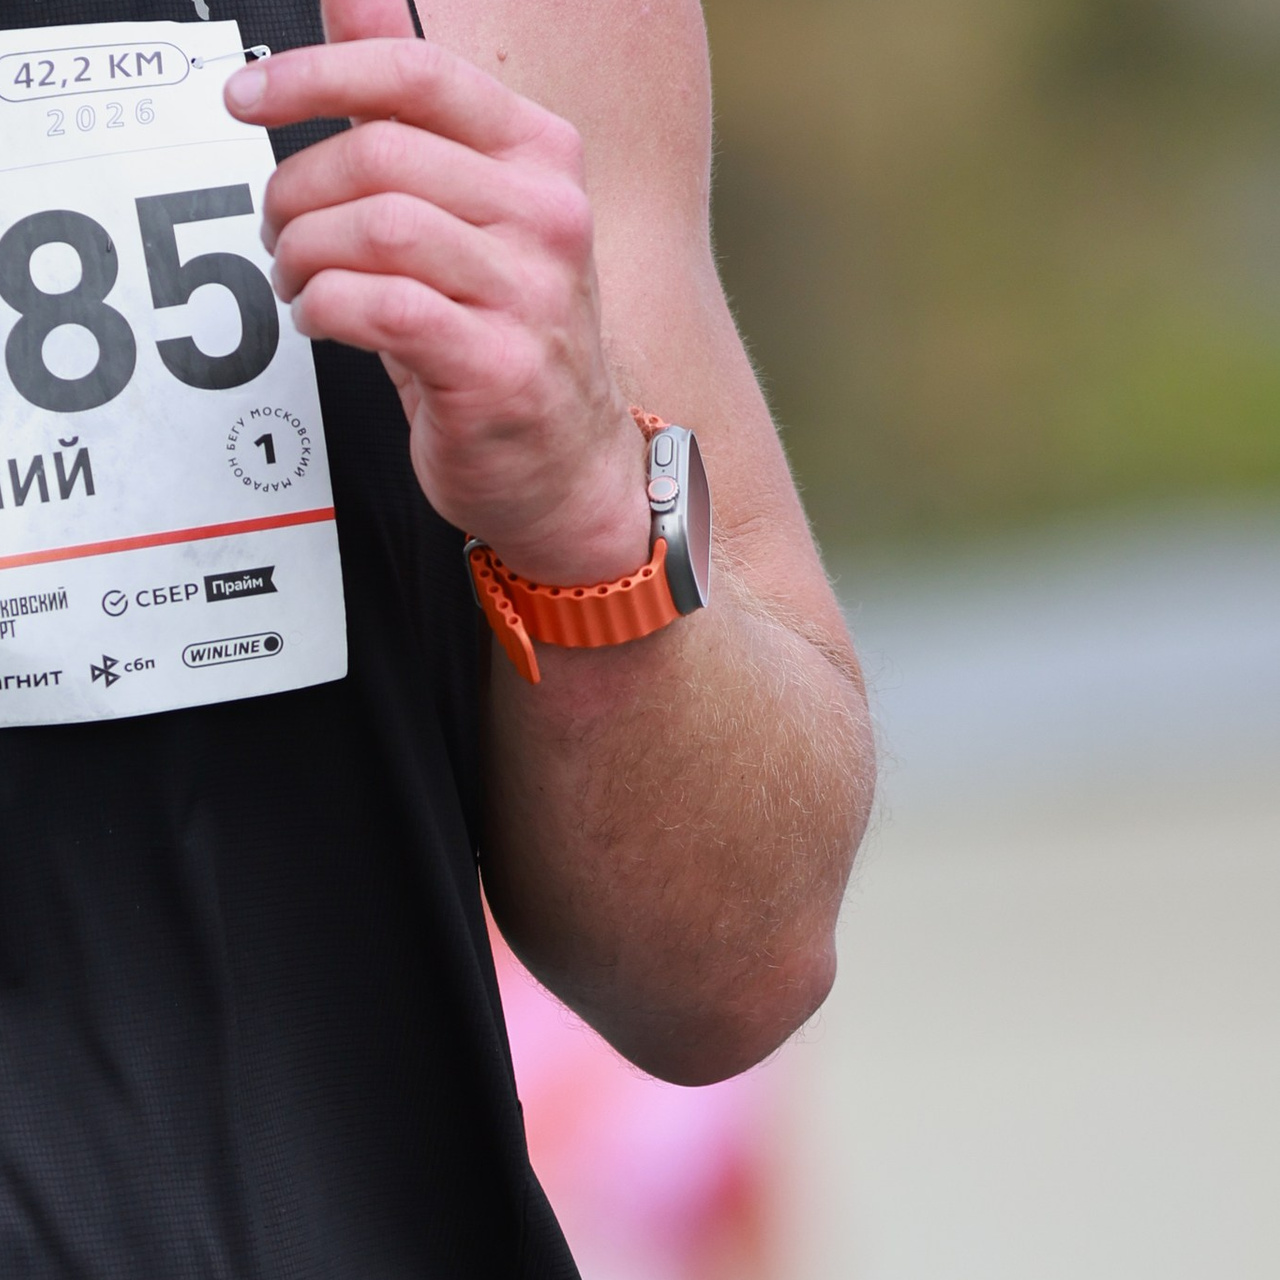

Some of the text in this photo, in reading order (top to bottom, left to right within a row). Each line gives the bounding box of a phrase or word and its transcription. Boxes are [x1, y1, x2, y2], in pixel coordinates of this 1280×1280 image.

[13, 55, 92, 89] 42,2
[46, 99, 155, 137] 2026
[226, 406, 311, 492] БЕГУ МОСКОВСКИЙ МАРАФОН
[253, 433, 276, 465] 1
[136, 576, 264, 608] СБЕР Прайм
[189, 639, 261, 663] WINLINE
